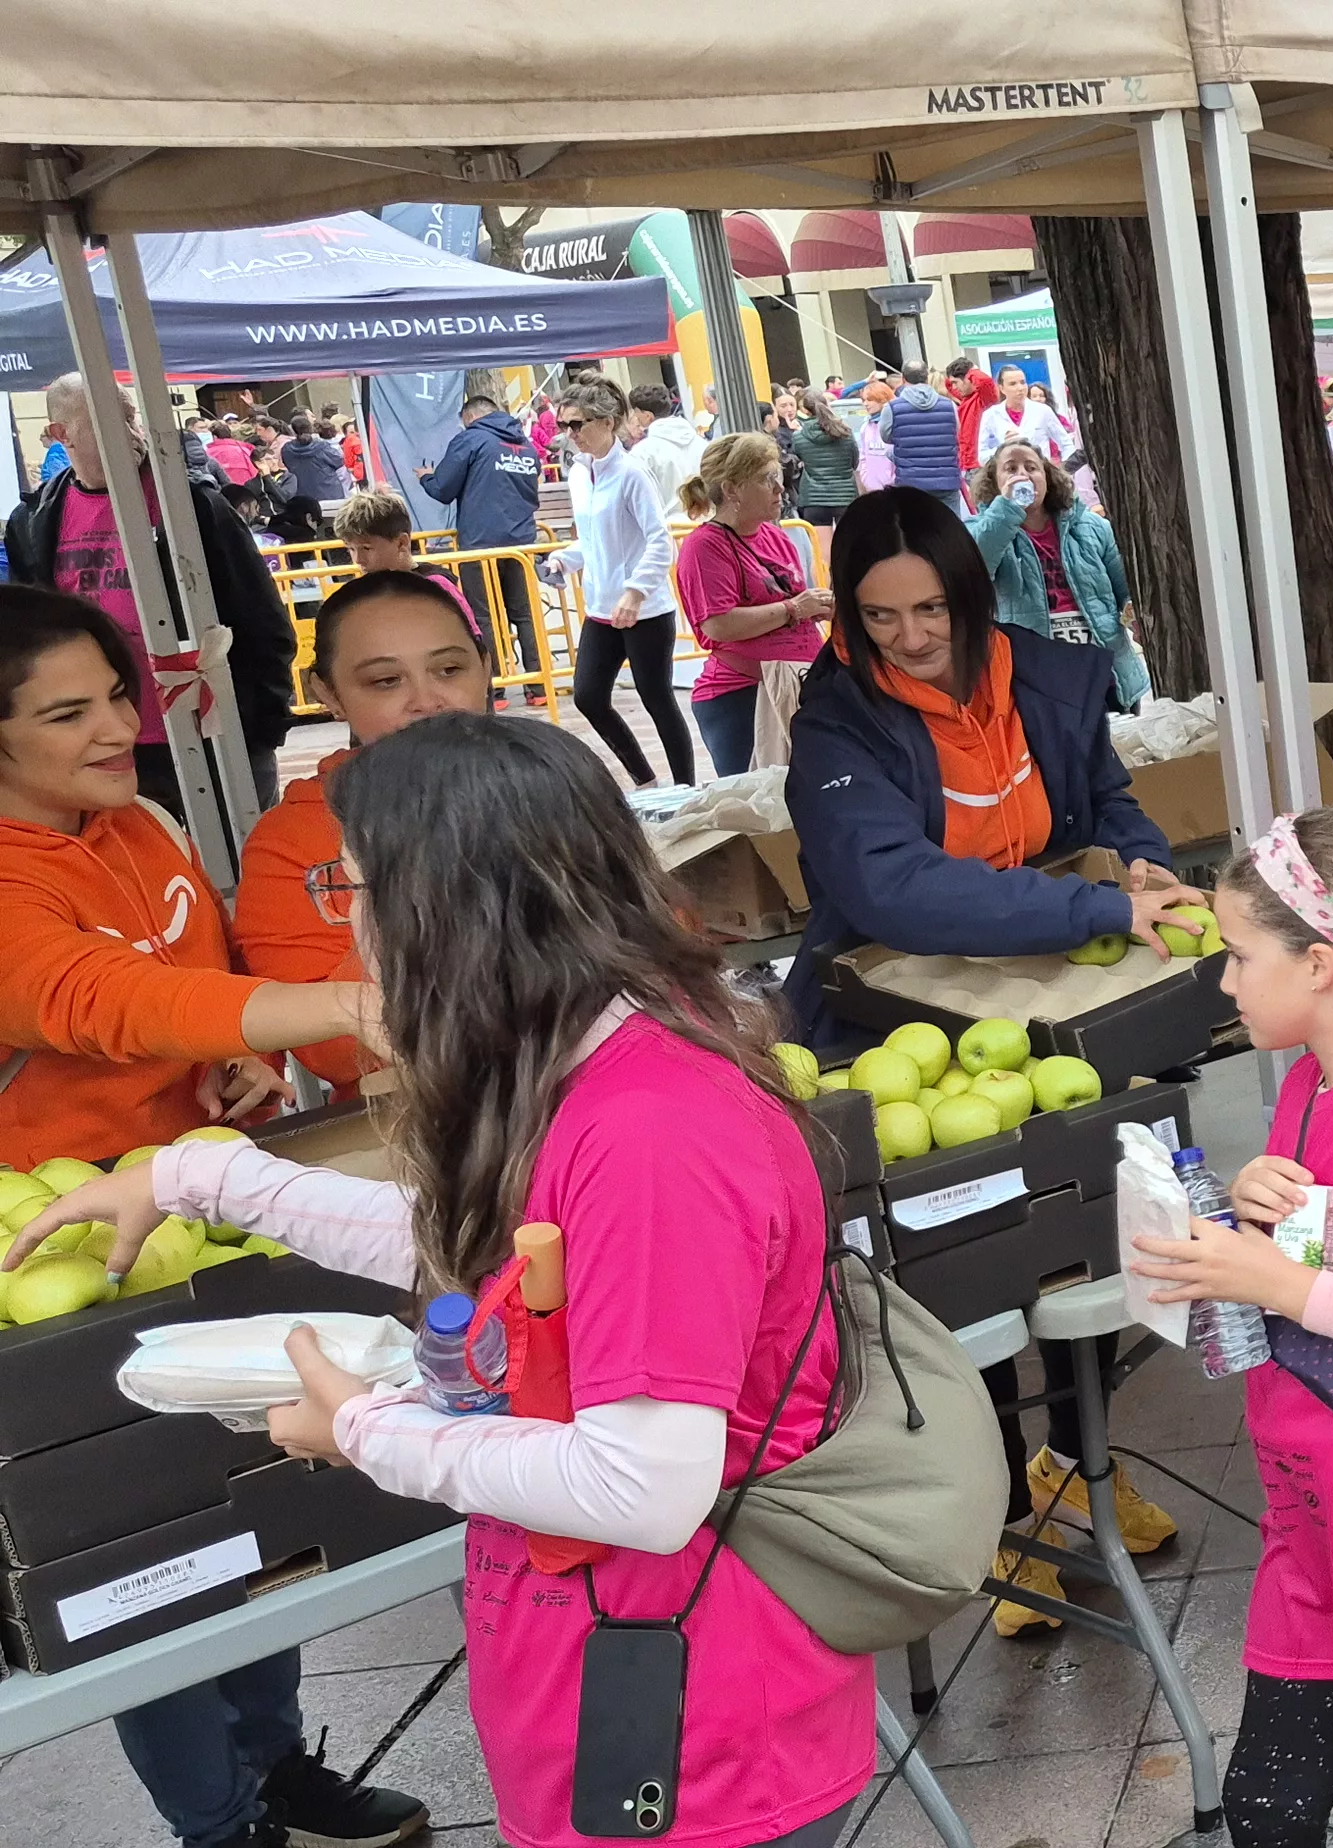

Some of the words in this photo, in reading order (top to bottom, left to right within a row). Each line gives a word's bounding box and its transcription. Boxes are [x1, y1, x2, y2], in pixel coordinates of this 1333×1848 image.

[521, 244, 557, 273] CAJA
[559, 235, 607, 268] RURAL
[191, 251, 313, 280] HAD
[245, 313, 548, 344] WWW.HADMEDIA.ES
[960, 318, 1015, 335] ASOCIACIÓN
[501, 453, 535, 466] HAD
[495, 461, 537, 475] MEDIA
[1277, 1223, 1313, 1235] Manzana
[1284, 1234, 1299, 1243] Uva
